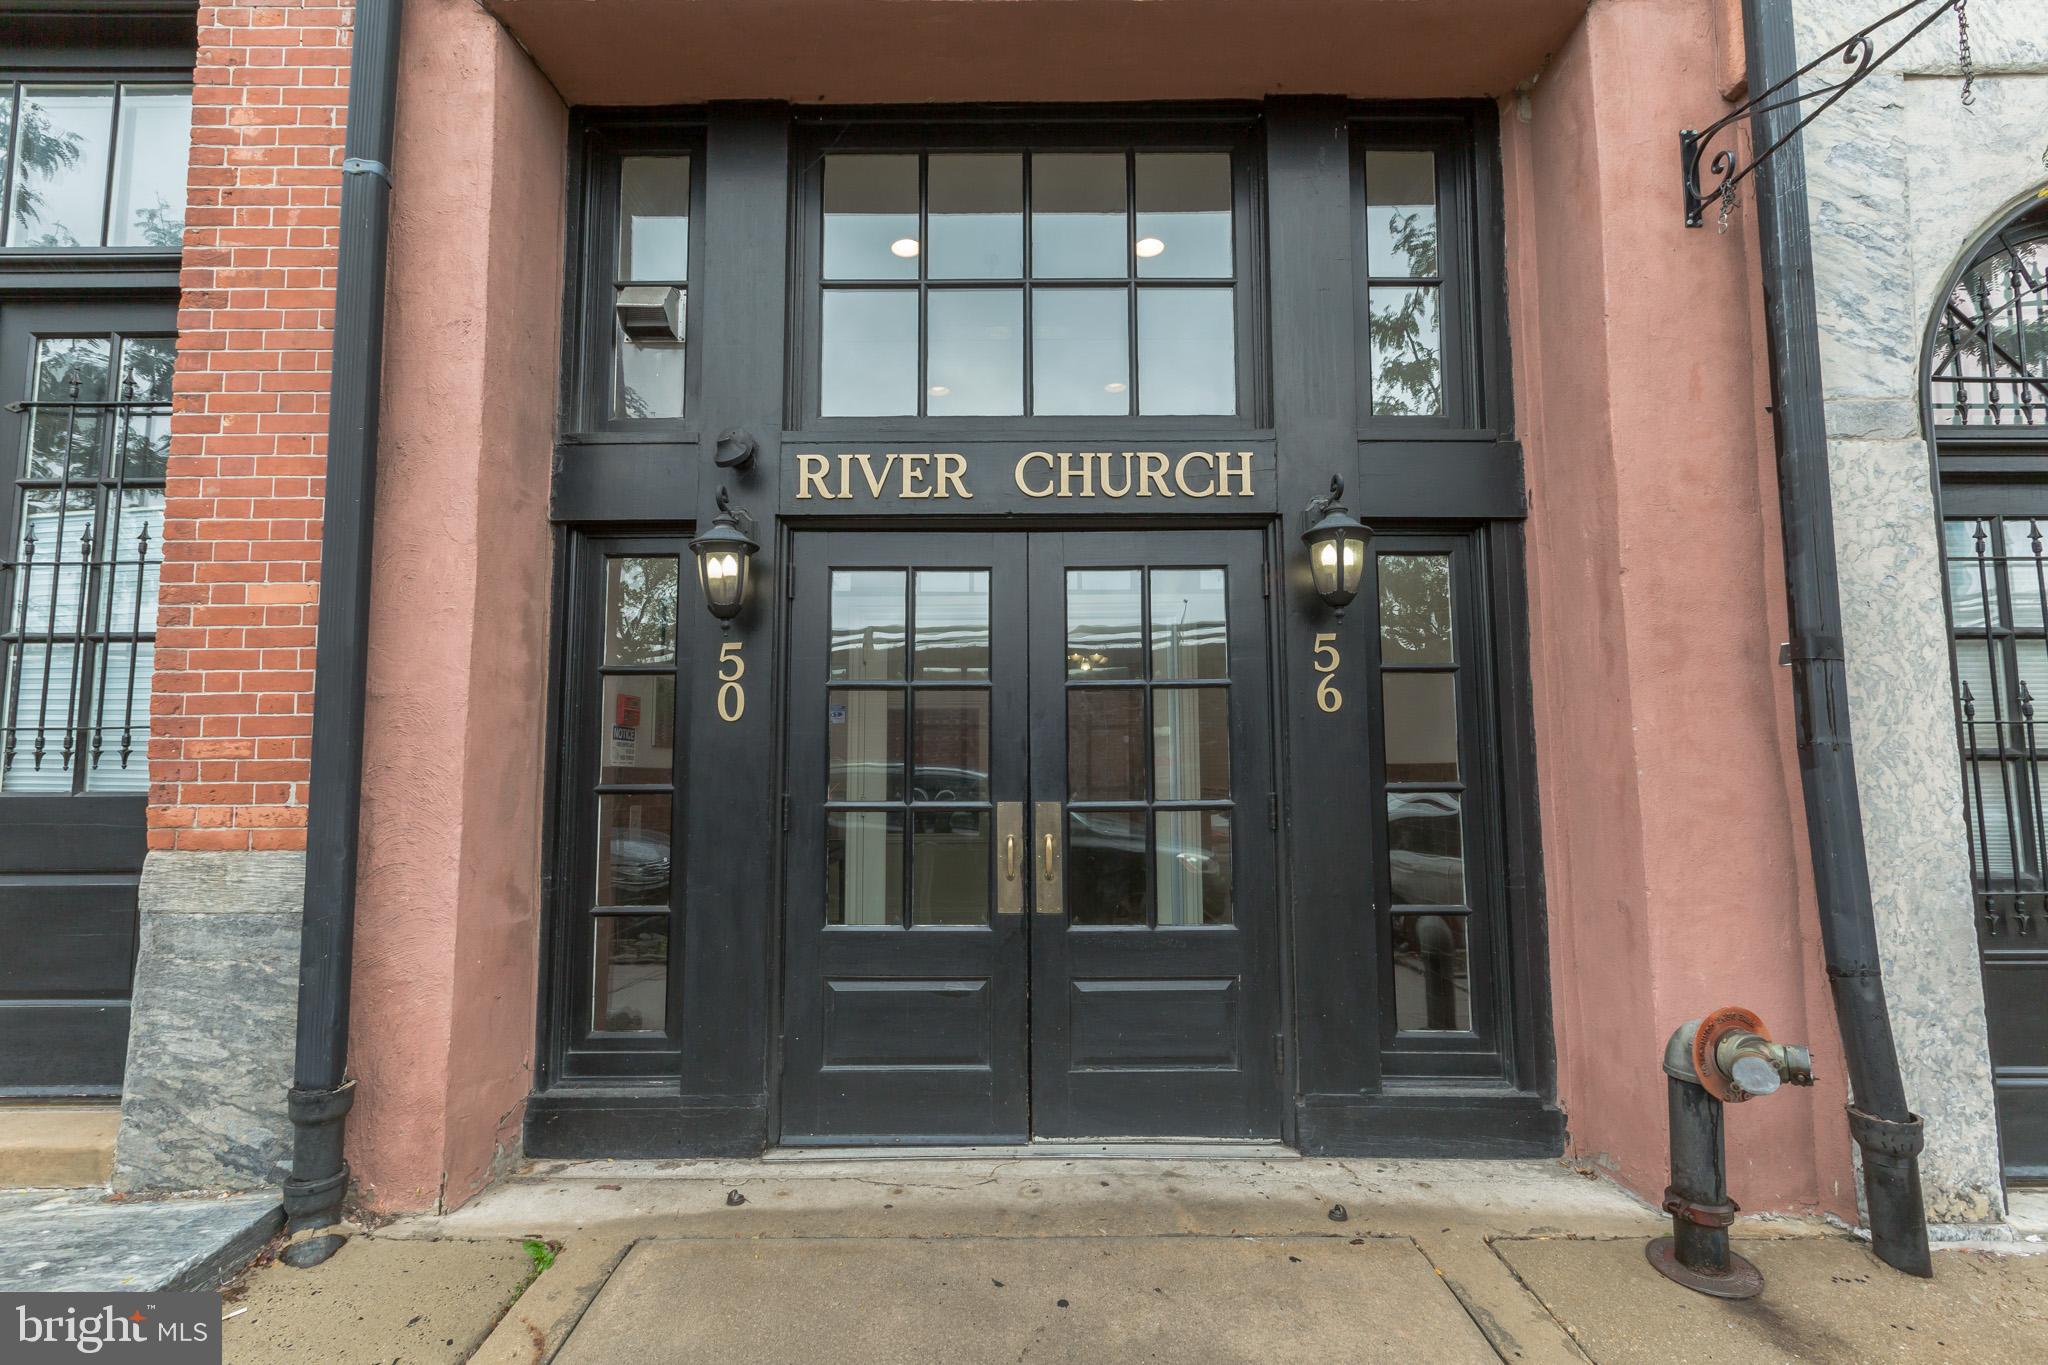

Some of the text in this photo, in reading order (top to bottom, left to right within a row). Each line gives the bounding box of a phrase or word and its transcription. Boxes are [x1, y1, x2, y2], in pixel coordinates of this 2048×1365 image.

[796, 451, 1255, 499] RIVER CHURCH
[717, 642, 745, 722] 50
[1314, 633, 1343, 713] 56
[613, 727, 635, 740] NOTICE
